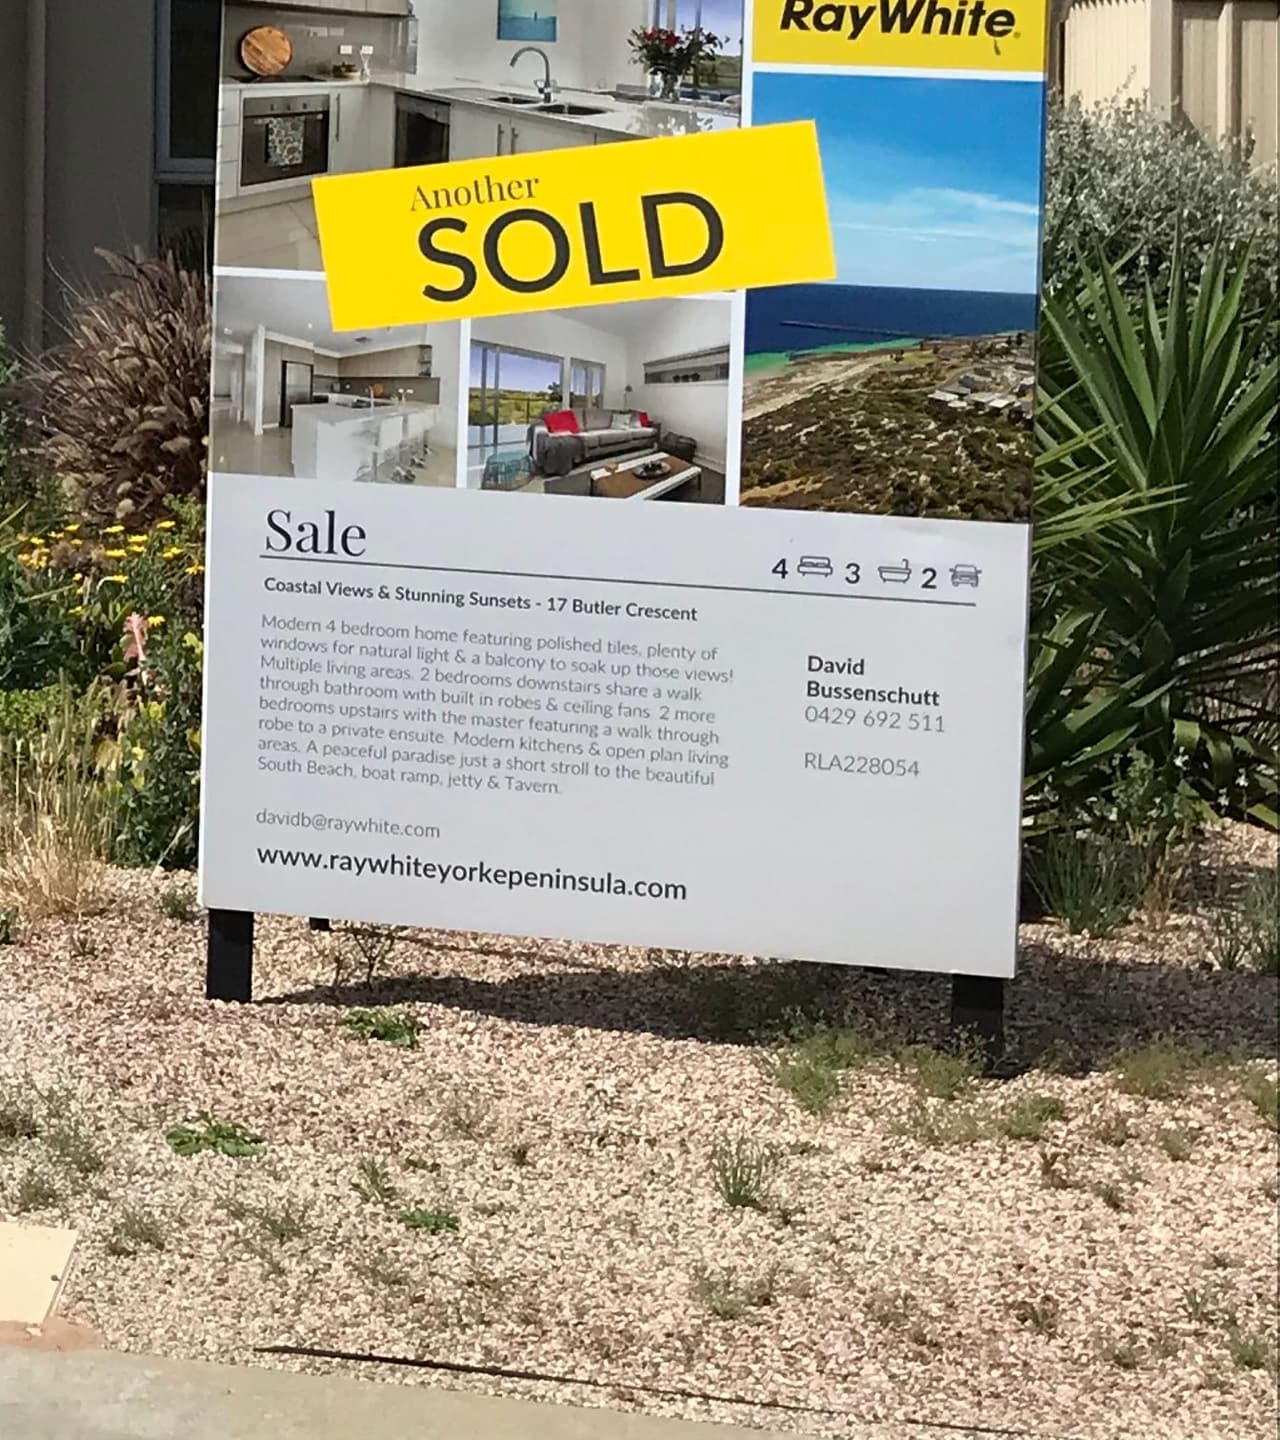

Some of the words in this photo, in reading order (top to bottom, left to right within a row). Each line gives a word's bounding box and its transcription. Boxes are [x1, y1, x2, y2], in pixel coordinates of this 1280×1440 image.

[410, 171, 540, 213] Another
[418, 191, 724, 302] SOLD
[266, 509, 366, 557] Sale
[771, 558, 789, 580] 4
[845, 562, 861, 585] 3
[921, 567, 937, 590] 2
[264, 577, 322, 595] Coastal
[325, 581, 374, 599] Views
[377, 585, 391, 600] &
[395, 586, 465, 608] Stunning
[469, 591, 531, 610] Sunsets
[547, 597, 568, 612] 17
[572, 598, 622, 616] Butler
[625, 602, 698, 622] Crescent
[260, 636, 328, 654] windows
[332, 639, 356, 655] for
[359, 644, 412, 660] natural
[417, 645, 450, 665] light
[454, 648, 467, 664] &
[471, 653, 481, 665] a
[485, 650, 548, 672] balcony
[550, 657, 567, 671] to
[571, 659, 606, 674] soak
[611, 664, 631, 678] up
[636, 662, 680, 680] those
[684, 669, 733, 683] views!
[261, 614, 322, 633] Modern
[325, 619, 337, 633] 4
[340, 619, 410, 639] bedroom
[414, 625, 459, 643] home
[462, 628, 533, 652] featuring
[536, 635, 602, 654] polished
[647, 642, 696, 662] plenty
[700, 647, 718, 661] of
[260, 654, 323, 675] Multiple
[326, 659, 367, 680] living
[420, 666, 430, 682] 2
[435, 667, 513, 688] bedrooms
[516, 674, 601, 695] downstairs
[605, 680, 648, 698] share
[652, 687, 662, 699] a
[666, 686, 702, 702] walk
[808, 655, 865, 676] David
[260, 674, 319, 696] through
[324, 679, 398, 700] bathroom
[402, 687, 436, 702] with
[440, 688, 474, 707] built
[479, 692, 494, 707] in
[497, 694, 542, 711] robes
[545, 696, 559, 712] &
[563, 699, 614, 719] ceiling
[659, 705, 670, 722] 2
[674, 709, 715, 724] more
[807, 680, 940, 707] Bussenschutt
[258, 715, 294, 732] robe
[298, 719, 314, 734] to
[318, 723, 327, 735] a
[331, 723, 385, 739] private
[453, 730, 515, 750] Modern
[519, 736, 584, 756] kitchens
[587, 741, 601, 757] &
[605, 746, 646, 761] open
[649, 746, 683, 763] plan
[688, 748, 729, 770] living
[259, 695, 336, 716] bedrooms
[339, 704, 399, 721] upstairs
[402, 707, 437, 723] with
[441, 709, 467, 726] the
[471, 715, 525, 730] master
[528, 715, 599, 739] featuring
[602, 725, 612, 737] a
[616, 724, 652, 740] walk
[657, 725, 719, 748] through
[804, 705, 856, 725] 0429
[863, 709, 901, 729] 692
[908, 711, 944, 733] 511
[257, 755, 302, 773] South
[361, 764, 396, 782] boat
[446, 772, 483, 791] jetty
[487, 775, 501, 790] &
[306, 739, 320, 754] A
[322, 744, 388, 761] peaceful
[391, 748, 456, 766] paradise
[458, 752, 488, 770] just
[492, 757, 501, 770] a
[506, 755, 546, 773] short
[550, 760, 589, 776] stroll
[594, 763, 611, 778] to
[615, 764, 641, 780] the
[645, 766, 715, 786] beautiful
[804, 752, 920, 777] RLA228054
[256, 808, 440, 839] davidb@raywhite.com
[257, 848, 686, 900] www.raywhiteyorkepeninsula.com
